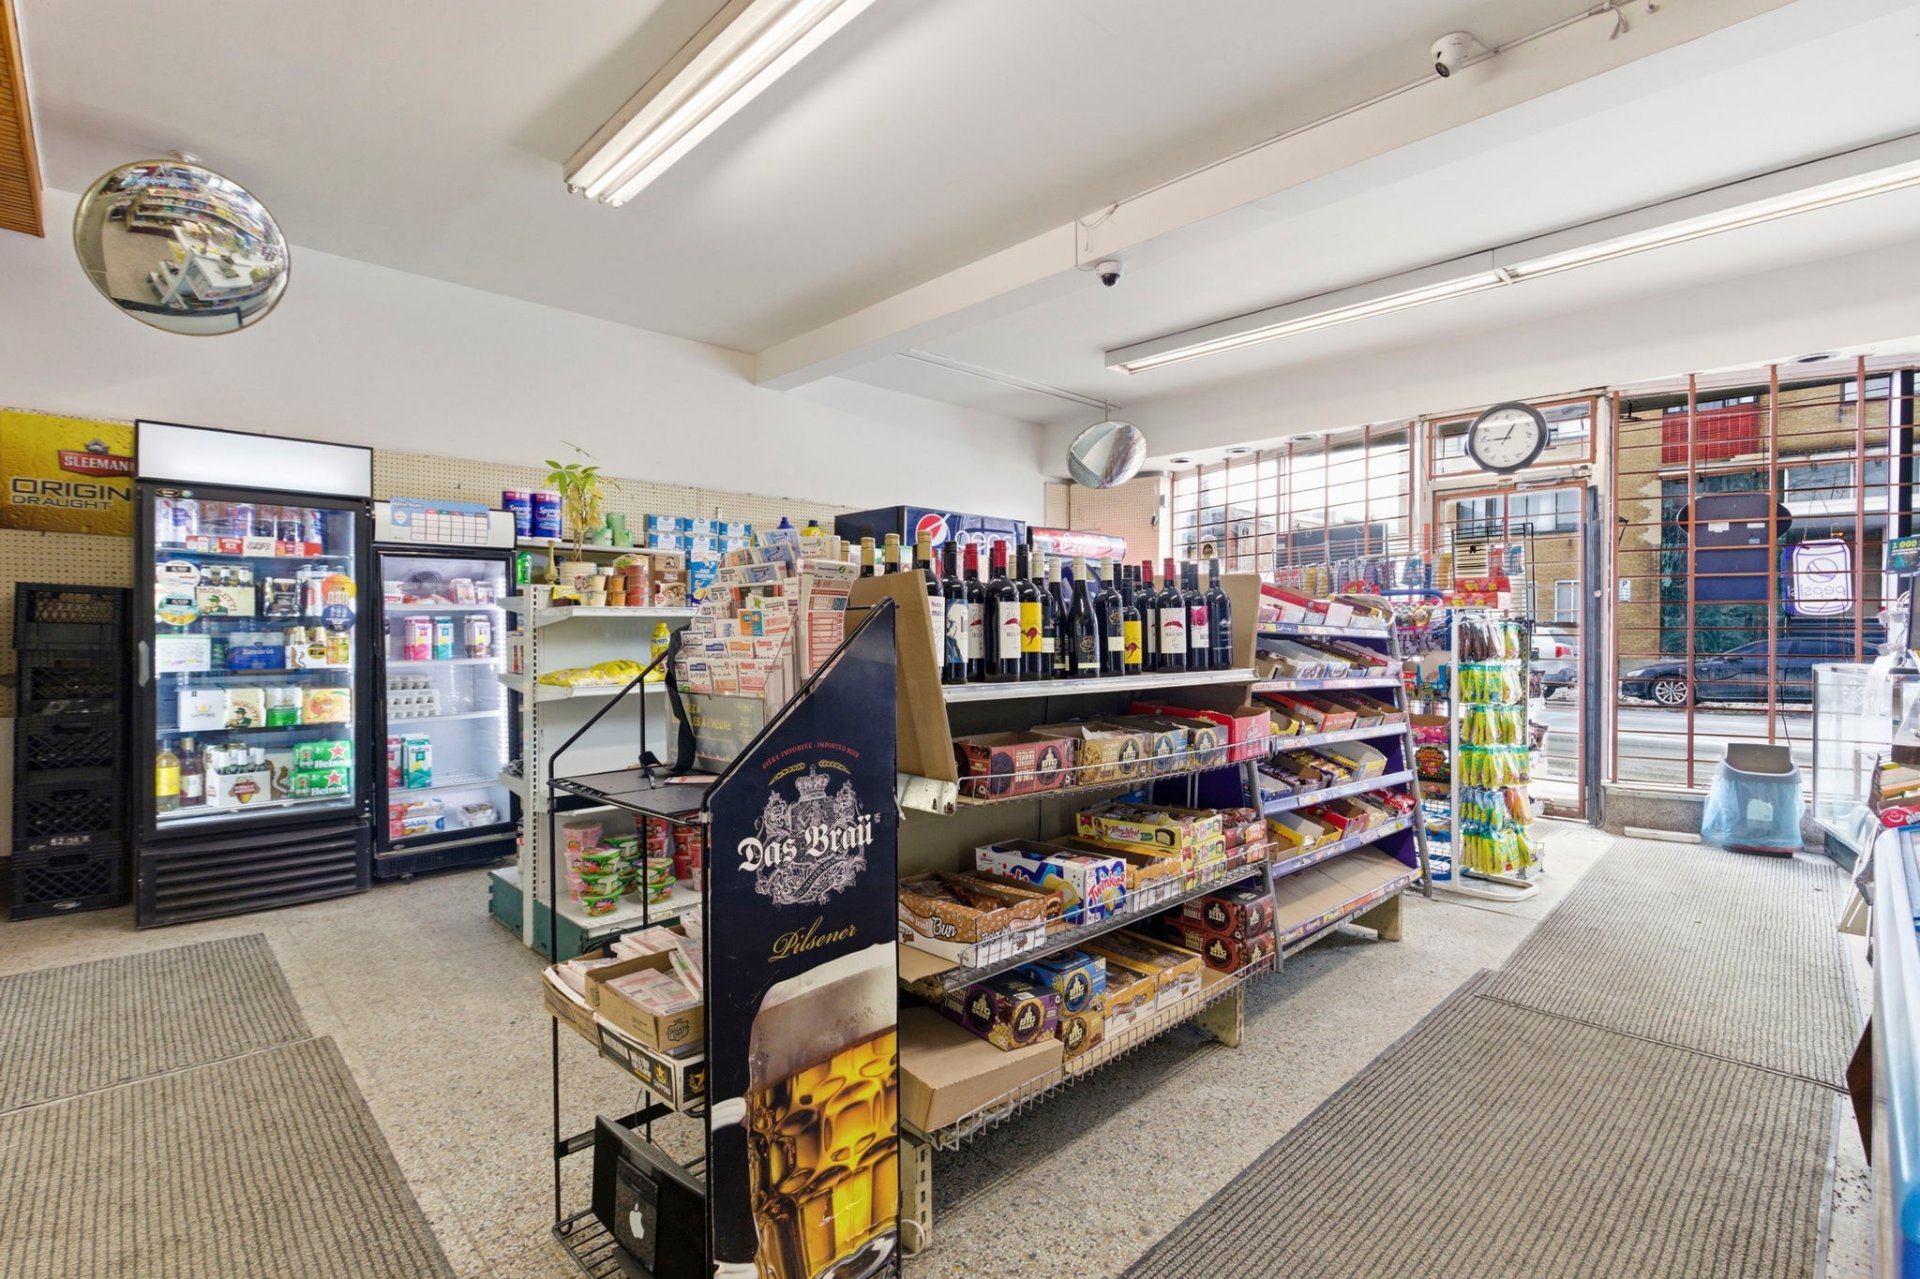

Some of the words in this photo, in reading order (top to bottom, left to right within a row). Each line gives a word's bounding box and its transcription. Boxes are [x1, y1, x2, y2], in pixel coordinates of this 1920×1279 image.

[64, 455, 128, 471] SLEEMAN
[12, 495, 111, 510] DRAUGHT
[1042, 759, 1058, 767] BIG
[738, 837, 797, 871] Das
[1088, 872, 1126, 903] Twinkies
[931, 915, 957, 938] Bun
[768, 916, 857, 963] Pilsener
[1070, 986, 1084, 995] BIG
[973, 1003, 991, 1016] BIG
[1020, 1015, 1036, 1025] BIG
[1069, 1028, 1083, 1039] BIG
